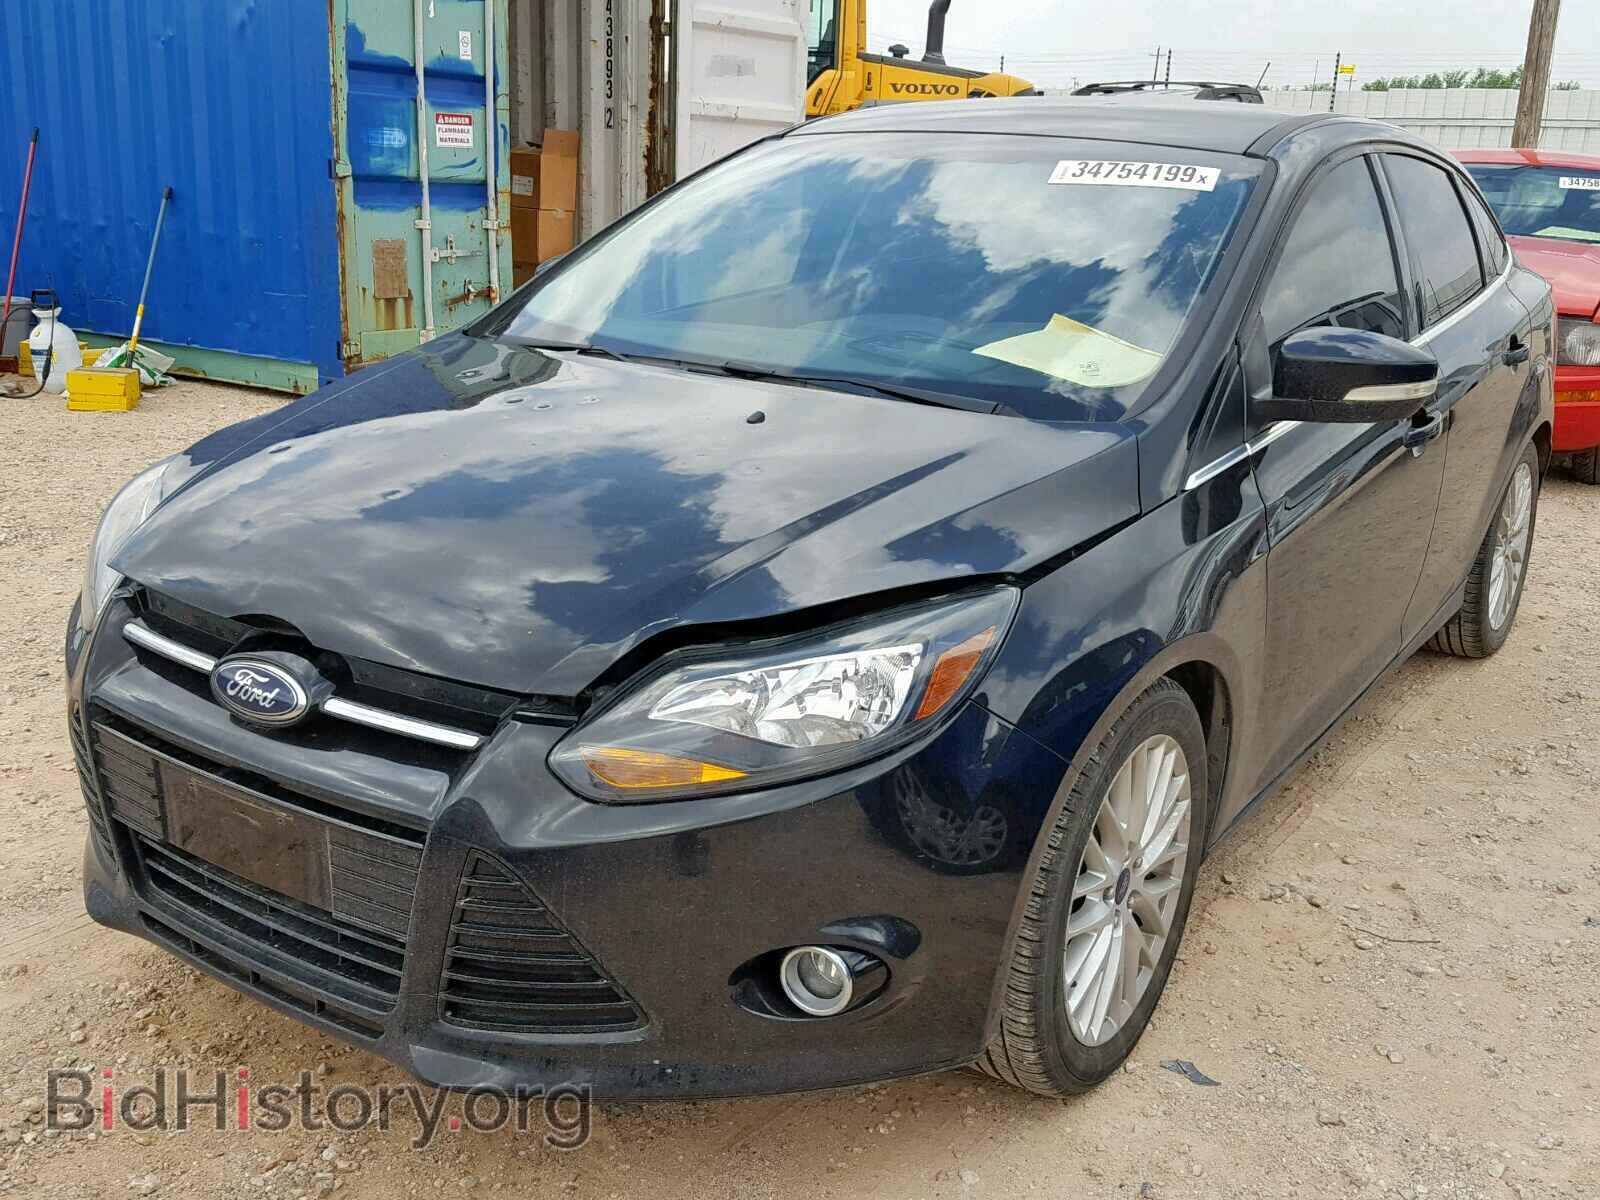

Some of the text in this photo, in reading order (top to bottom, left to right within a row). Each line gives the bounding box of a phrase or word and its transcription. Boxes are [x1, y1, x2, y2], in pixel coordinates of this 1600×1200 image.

[889, 82, 960, 96] VOLVO
[444, 116, 470, 124] DANGER
[440, 136, 470, 144] MATERIALS
[226, 668, 280, 708] Ford
